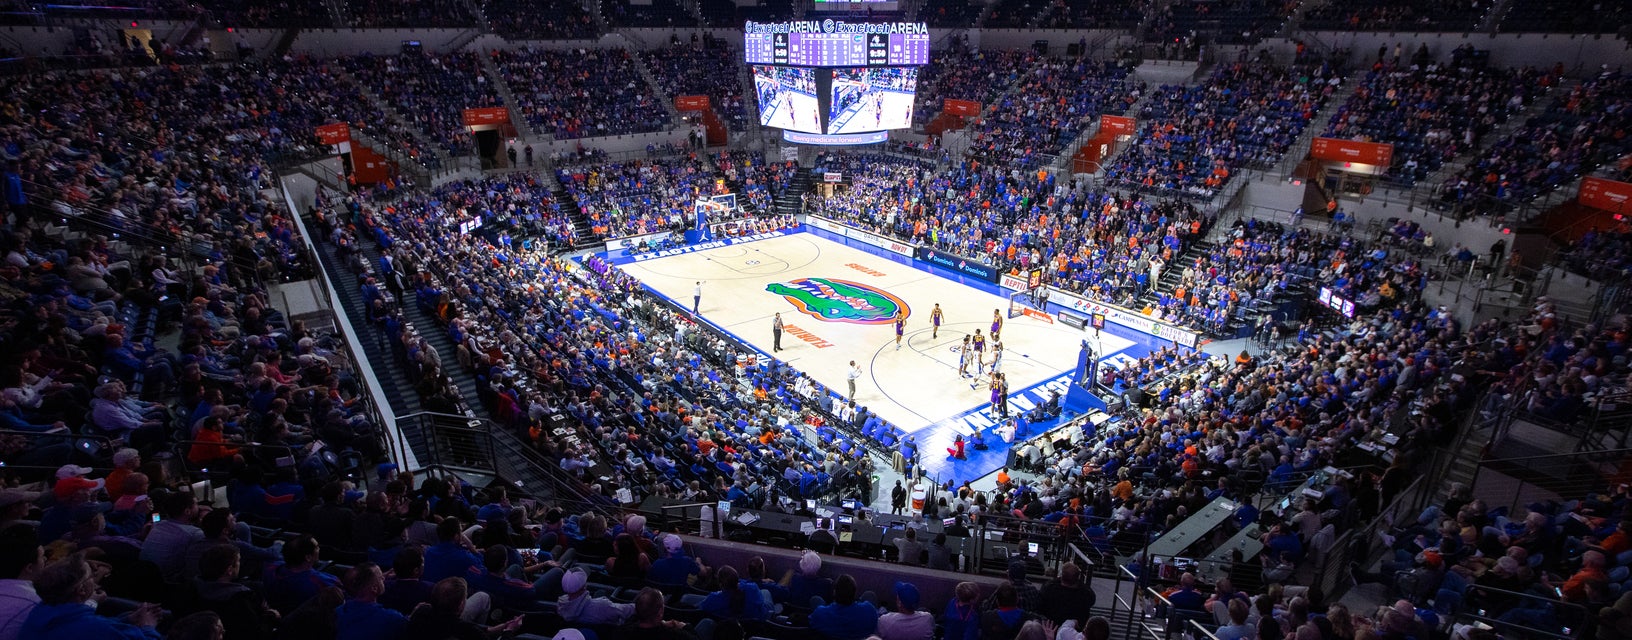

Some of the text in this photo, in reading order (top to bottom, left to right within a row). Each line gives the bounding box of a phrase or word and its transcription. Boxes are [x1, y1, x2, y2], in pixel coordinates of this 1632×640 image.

[790, 21, 821, 33] ARENA
[835, 21, 928, 34] Exactech ARENA
[933, 255, 954, 267] Domino's
[965, 265, 988, 278] Domino's
